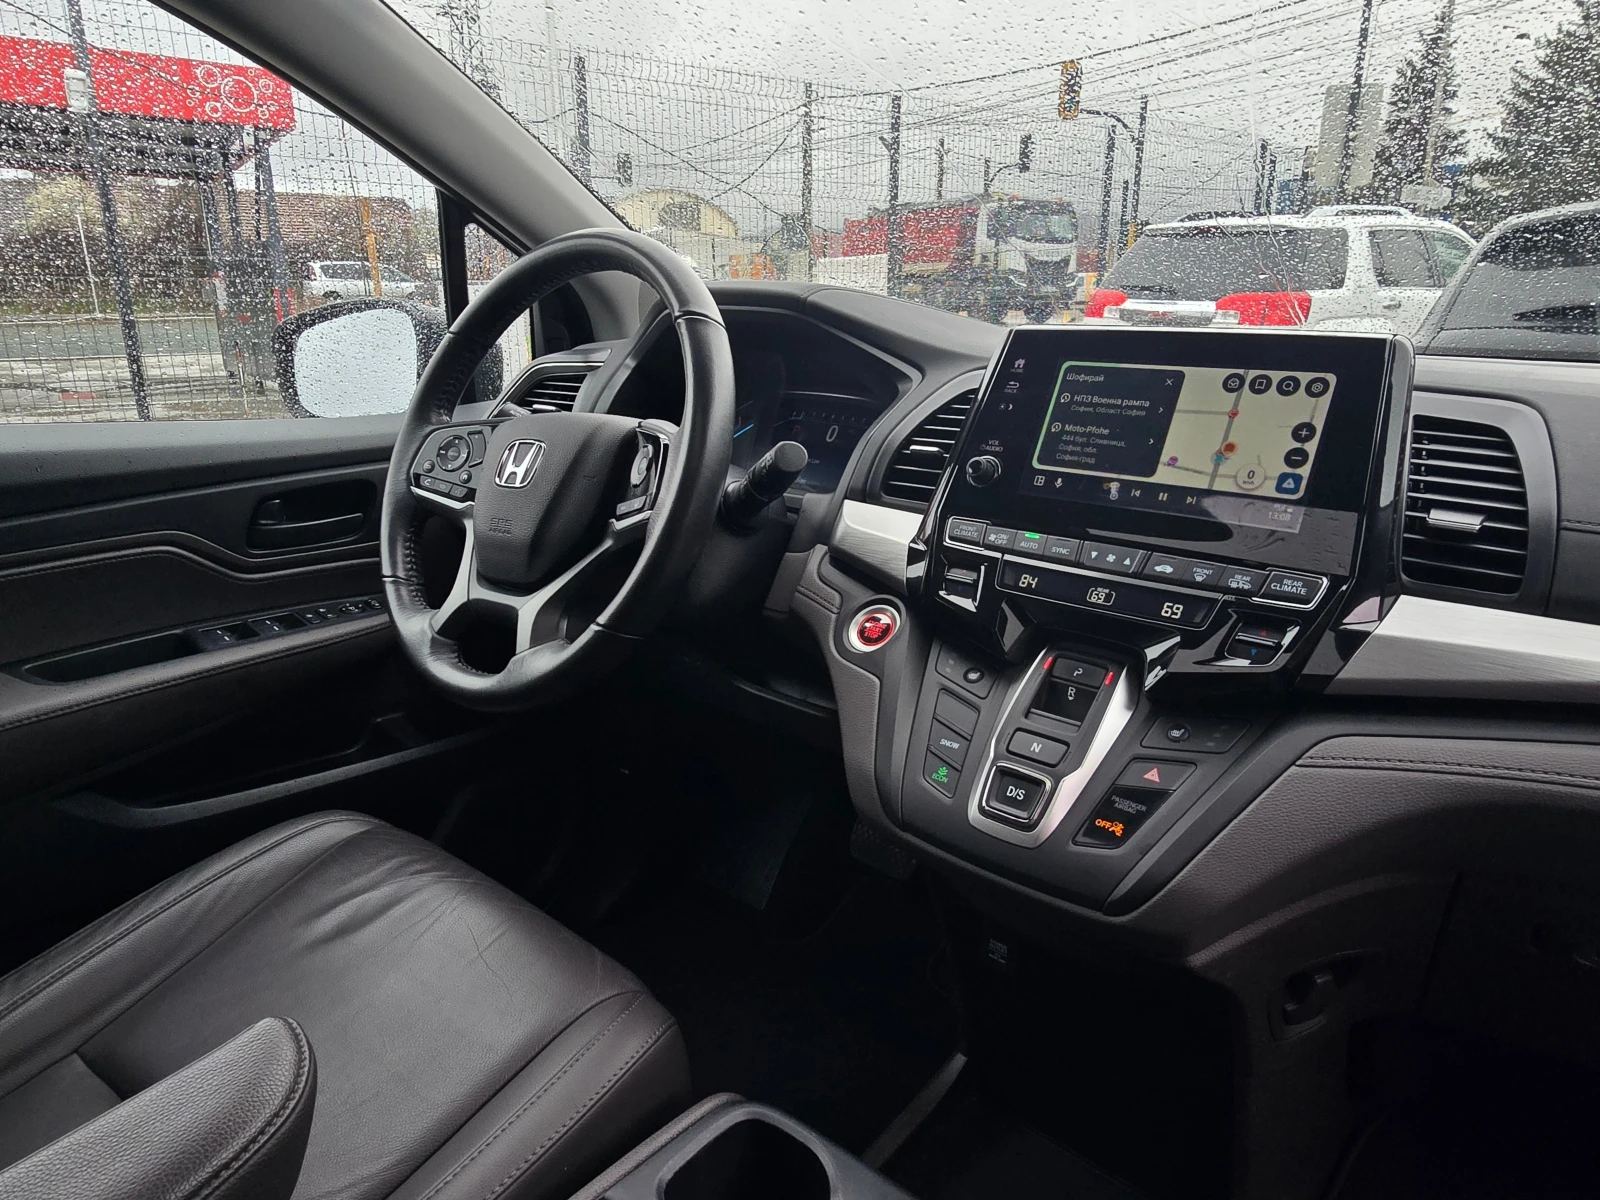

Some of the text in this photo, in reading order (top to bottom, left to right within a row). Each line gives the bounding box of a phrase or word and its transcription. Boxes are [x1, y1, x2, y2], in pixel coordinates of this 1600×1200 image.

[1066, 373, 1104, 382] Шофирай
[1073, 394, 1150, 408] НПЗ Военна рампа
[1095, 406, 1121, 414] Област
[1122, 408, 1146, 416] София
[826, 425, 839, 443] 0
[1064, 424, 1110, 435] Moto-Pfohe
[1089, 436, 1126, 448] Сливница,
[1083, 446, 1098, 454] обл.
[1055, 453, 1096, 464] София-град
[1247, 469, 1255, 480] 0
[1268, 511, 1291, 521] 13:08
[953, 529, 979, 538] CLIMATE
[959, 524, 977, 532] FRONT
[994, 538, 1007, 546] OFF
[1019, 540, 1039, 550] AUTO
[1050, 546, 1070, 555] SYNC
[1193, 567, 1213, 575] FRONT
[1018, 573, 1038, 589] 84
[1234, 574, 1252, 582] REAR
[1283, 578, 1303, 587] REAR
[1270, 582, 1308, 596] CLIMATE
[1090, 592, 1105, 602] 69
[1161, 602, 1183, 619] 69
[1067, 686, 1076, 698] R
[939, 738, 960, 750] SNOW
[1030, 742, 1042, 753] N
[931, 772, 949, 783] ECON
[1006, 785, 1026, 800] D/S
[1111, 795, 1147, 811] PASSENGER
[1114, 802, 1137, 814] AIRBAG
[1095, 818, 1112, 829] OFF
